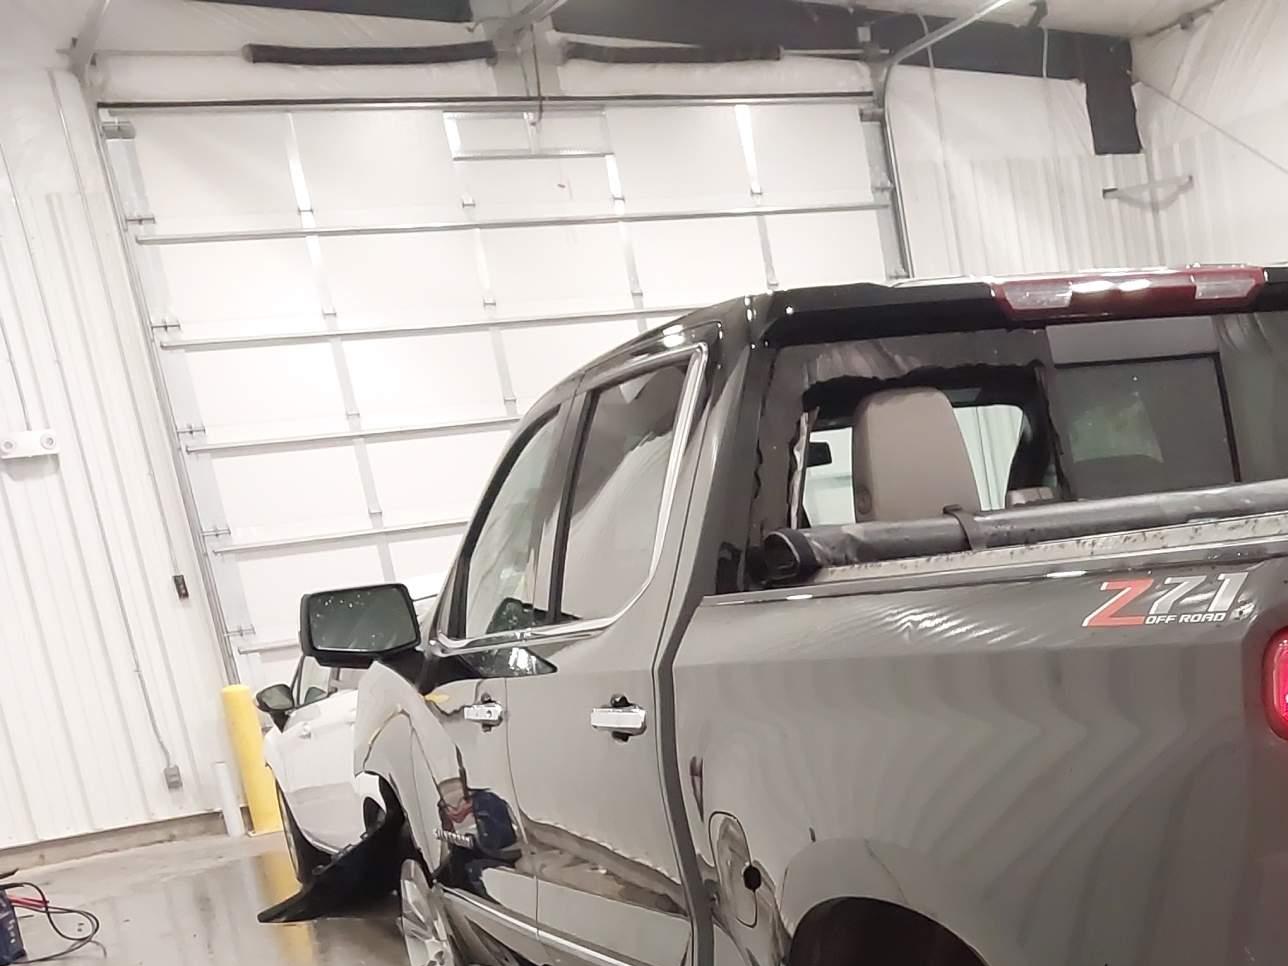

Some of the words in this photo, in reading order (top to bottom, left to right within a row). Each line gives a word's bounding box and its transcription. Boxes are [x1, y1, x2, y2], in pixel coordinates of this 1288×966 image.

[1082, 571, 1249, 627] Z71
[1145, 614, 1177, 625] OFF
[1178, 611, 1228, 624] ROAD
